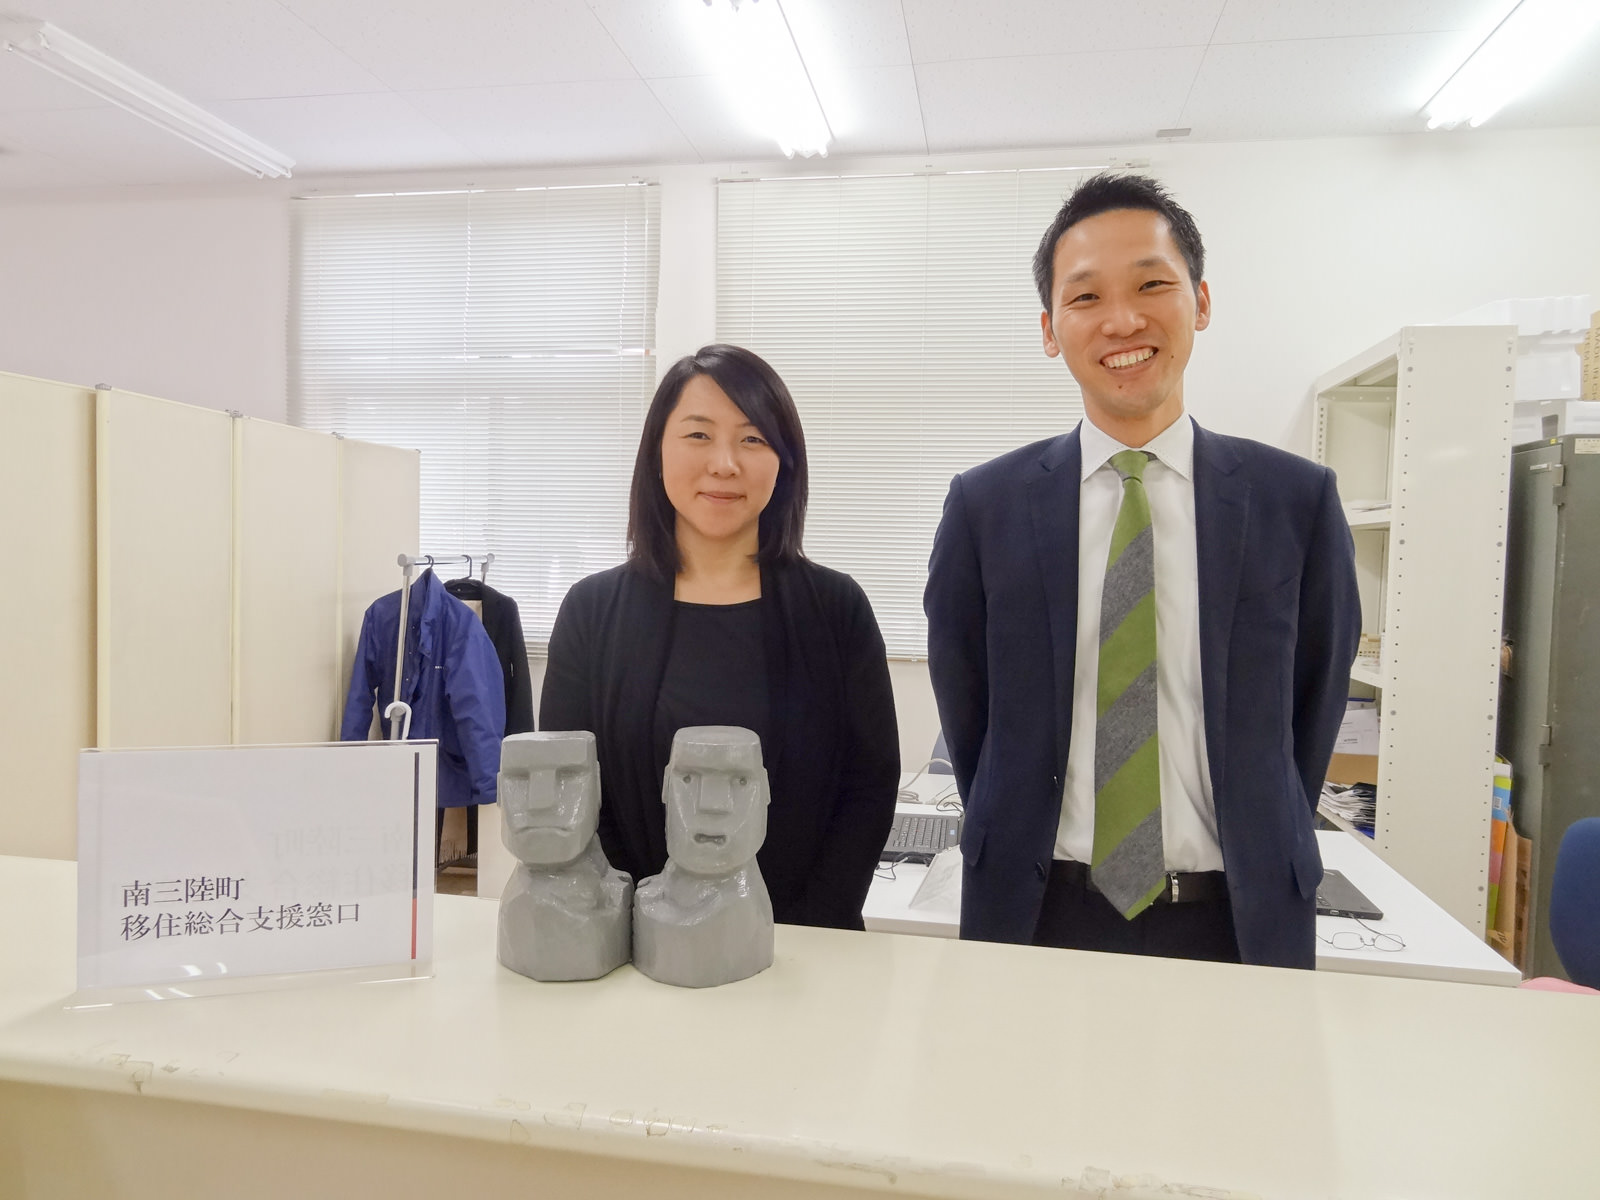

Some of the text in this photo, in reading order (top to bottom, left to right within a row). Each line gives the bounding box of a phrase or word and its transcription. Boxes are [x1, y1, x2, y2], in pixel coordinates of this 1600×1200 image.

[121, 876, 246, 908] 南三陸町
[120, 902, 361, 941] 移住総合支援窓口
